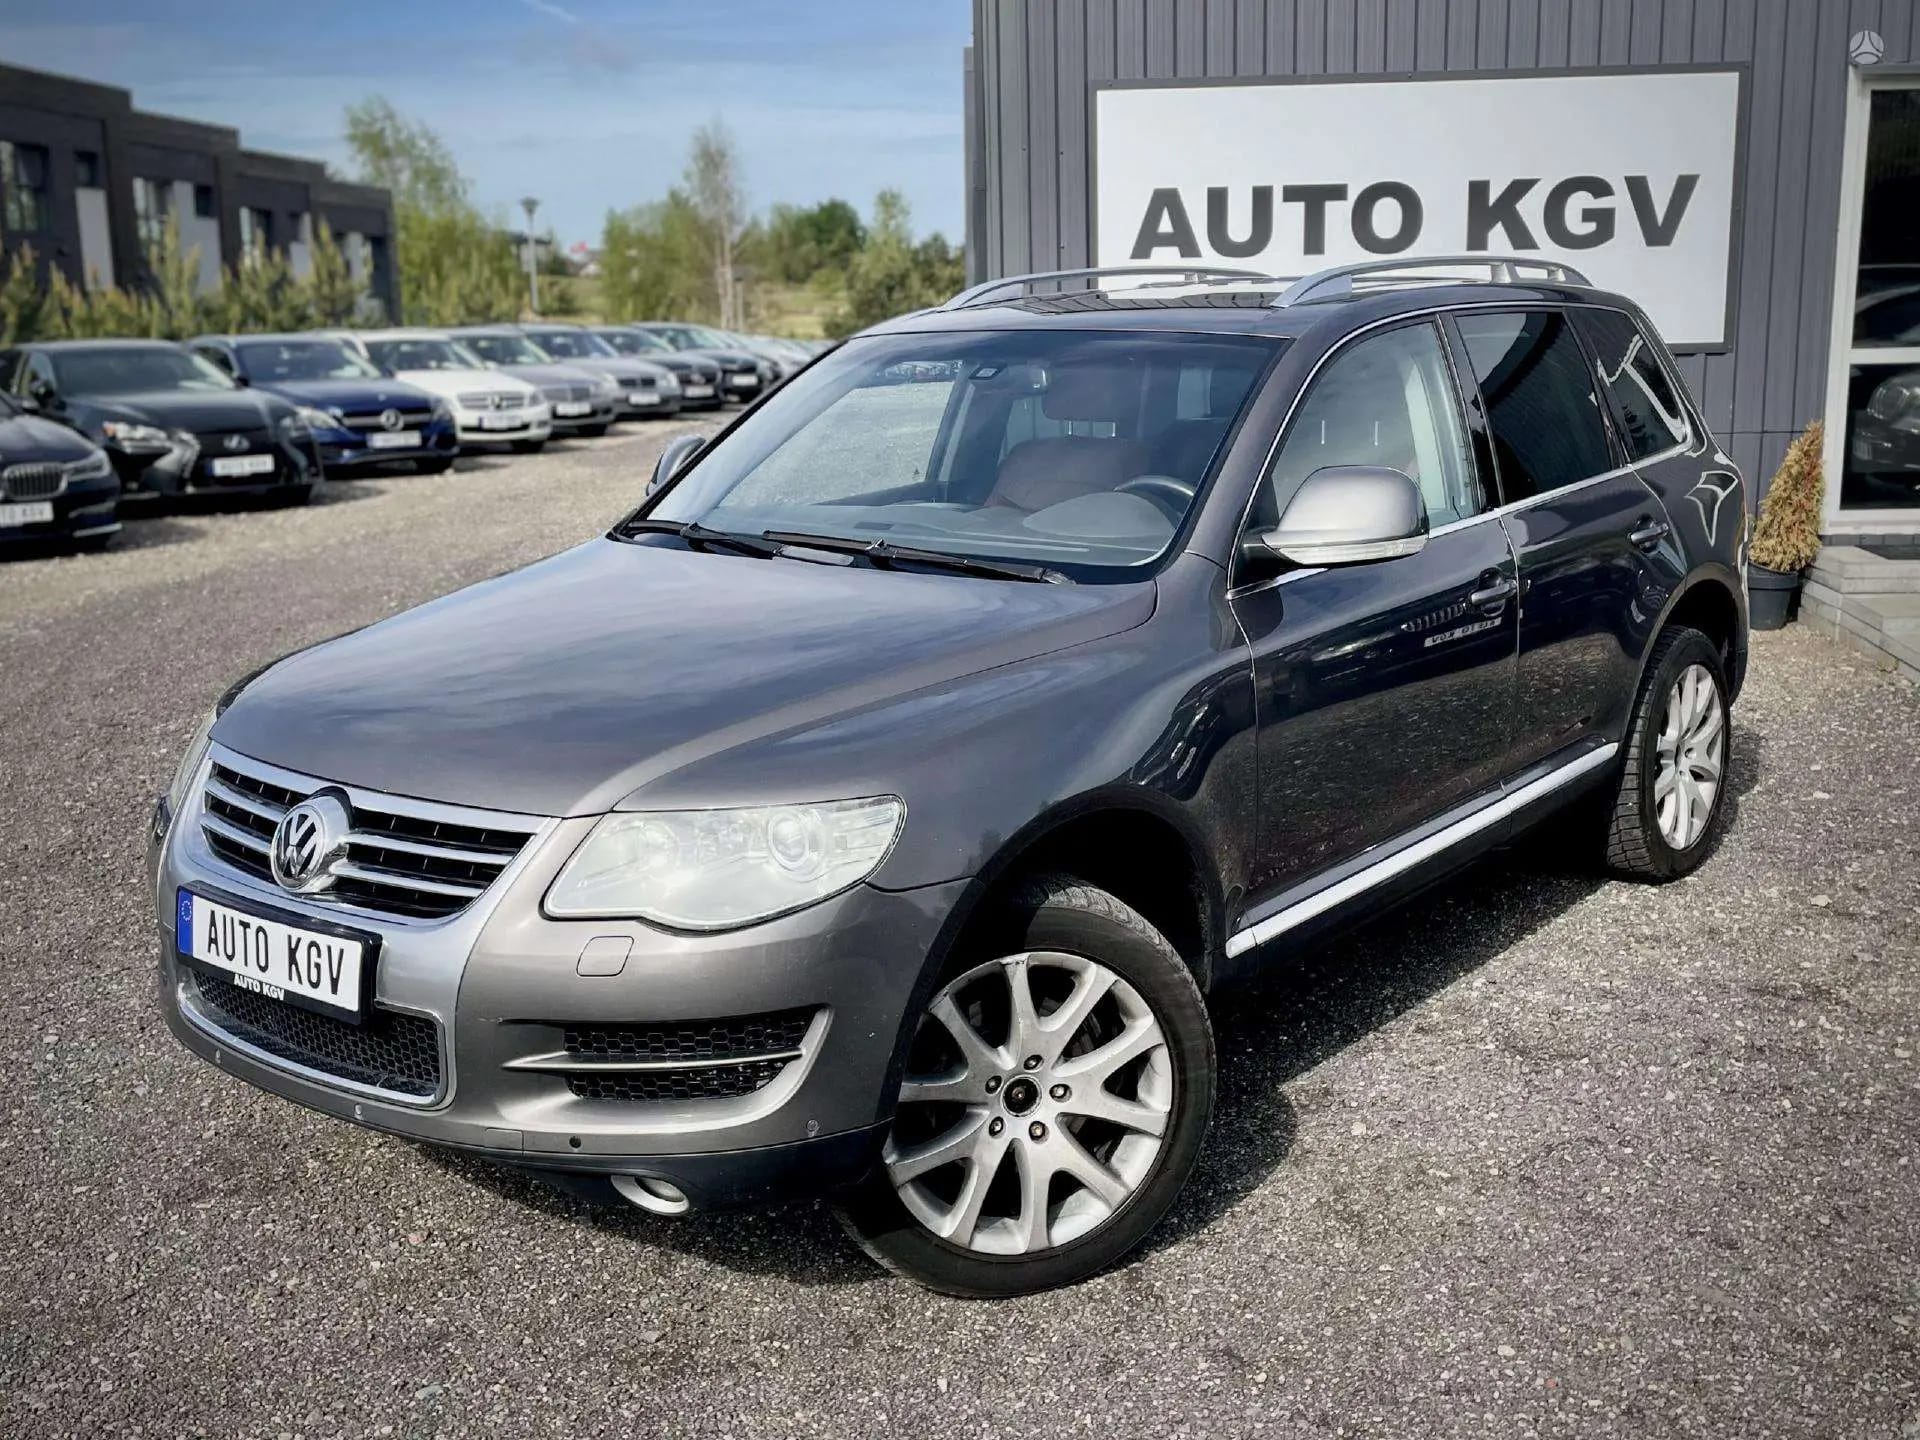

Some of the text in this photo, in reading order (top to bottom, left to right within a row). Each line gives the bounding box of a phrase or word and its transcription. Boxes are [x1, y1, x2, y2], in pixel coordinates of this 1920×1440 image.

[1130, 173, 1701, 260] AUTO KGV
[207, 909, 345, 996] AUTO KGV
[233, 973, 285, 1001] AUTO KGV
